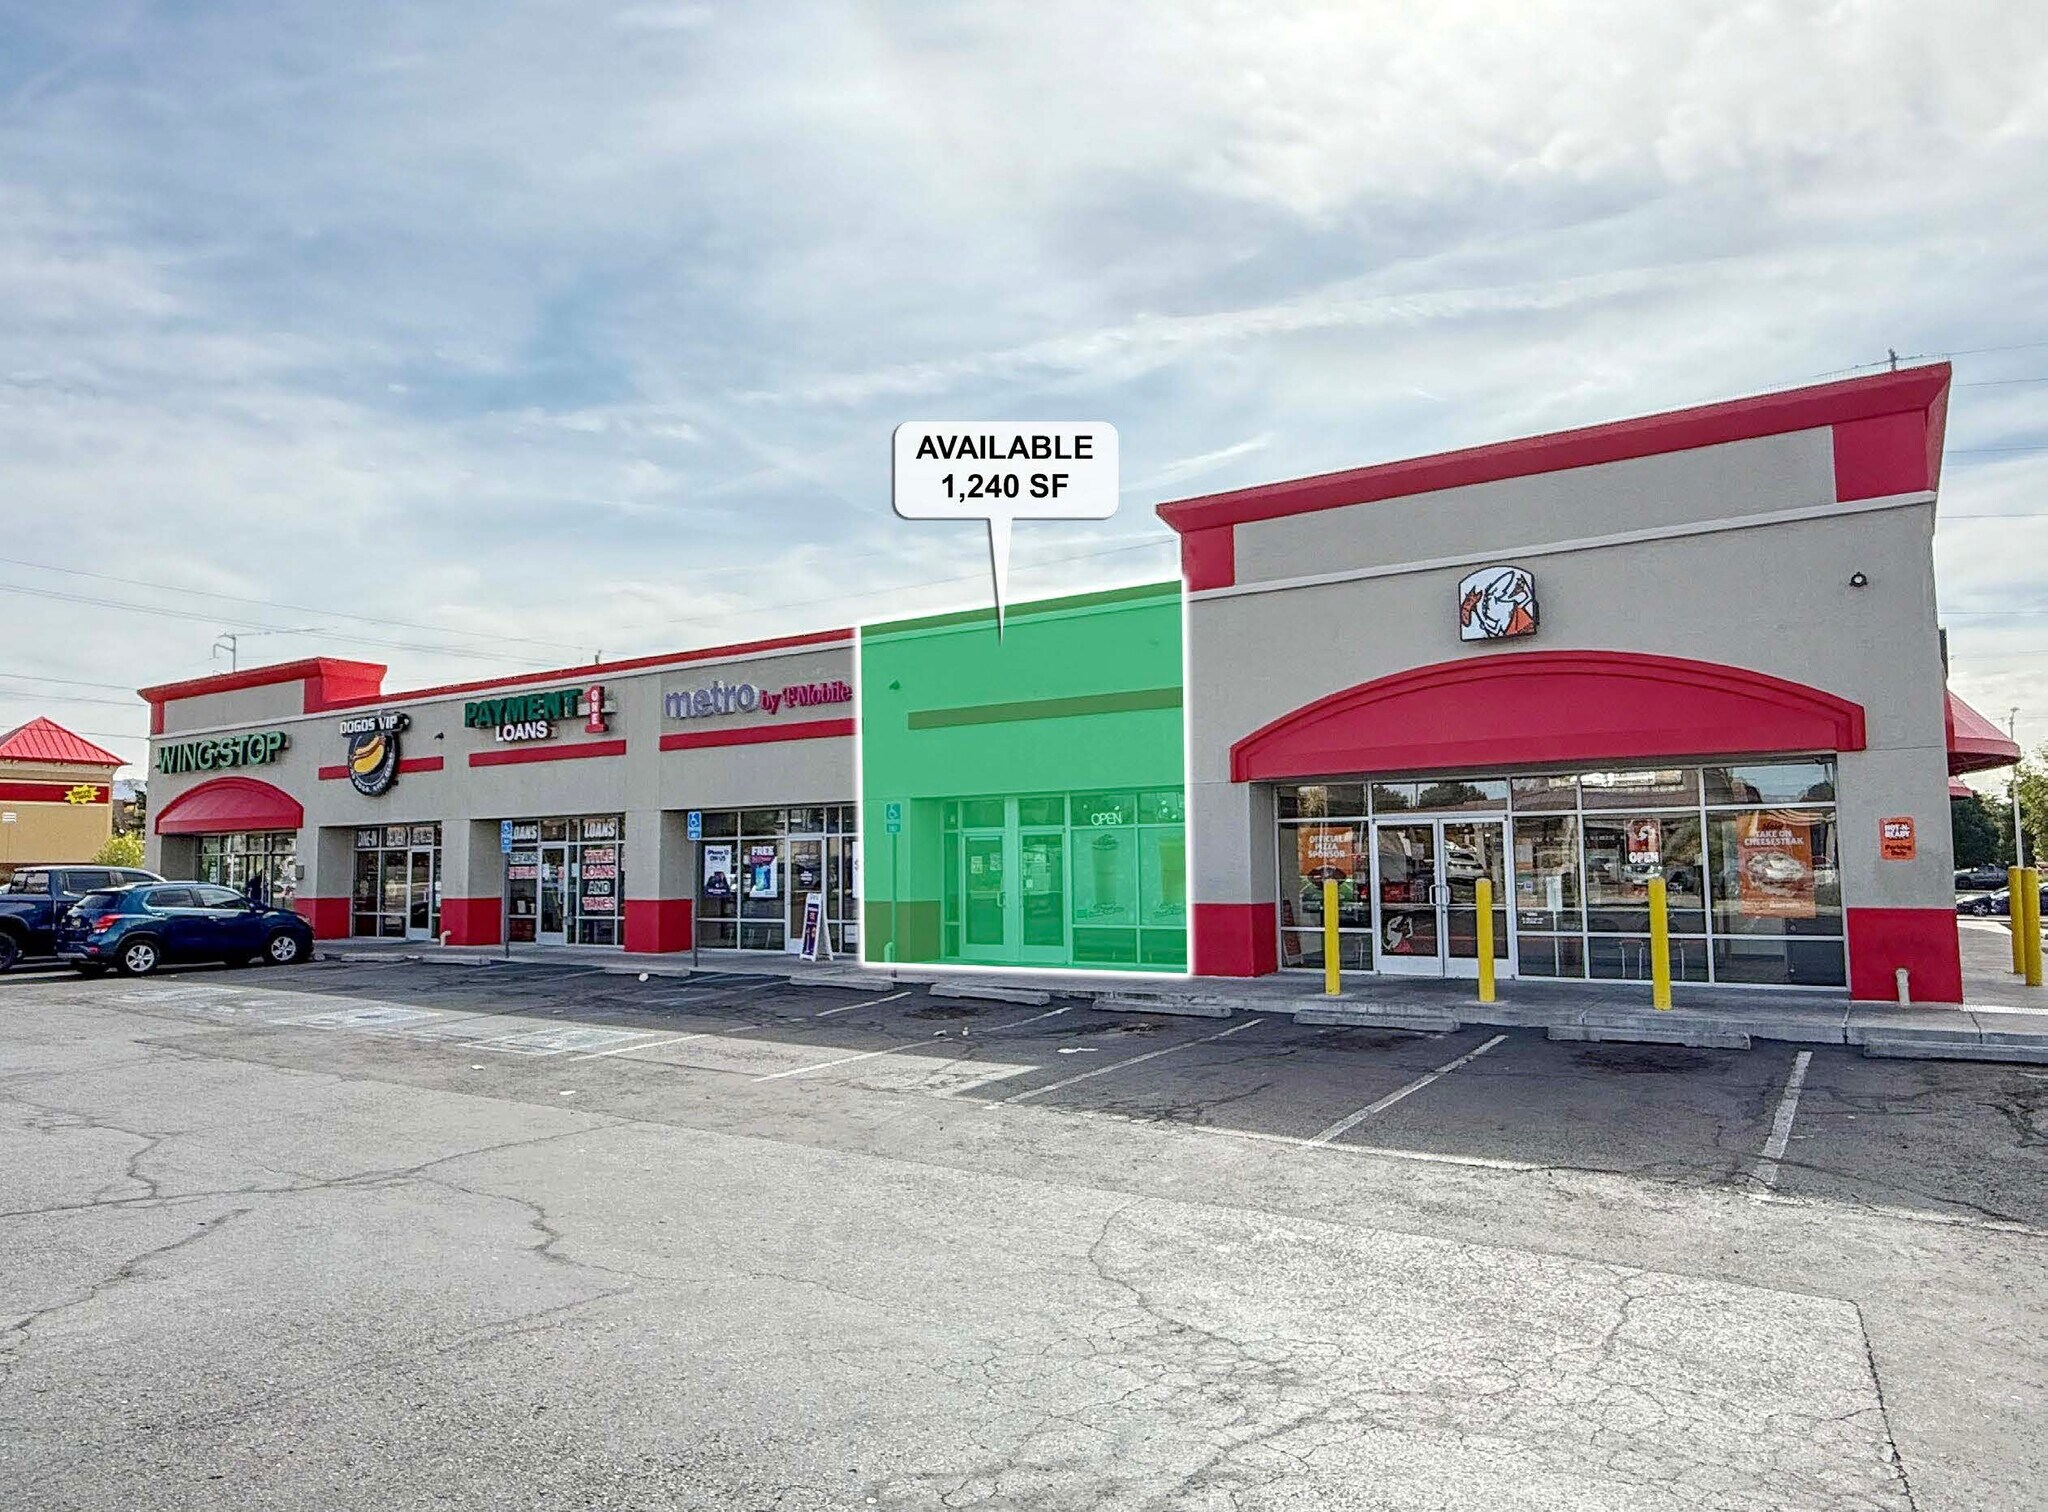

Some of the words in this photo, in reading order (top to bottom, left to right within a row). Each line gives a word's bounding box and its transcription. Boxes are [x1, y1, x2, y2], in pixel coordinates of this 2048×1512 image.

[664, 680, 760, 719] metro
[759, 690, 782, 715] by
[465, 688, 583, 727] PAYMENT
[340, 717, 376, 734] DOGOS
[378, 714, 398, 730] VIP
[495, 720, 548, 742] LOANS
[1091, 812, 1122, 826] OPEN
[513, 825, 538, 840] OANS
[583, 818, 616, 838] LOANS
[751, 847, 774, 856] FREE
[1308, 850, 1346, 858] SPONSOR
[1628, 851, 1660, 864] OPEN
[582, 865, 616, 879] LOANS
[588, 881, 611, 895] AND
